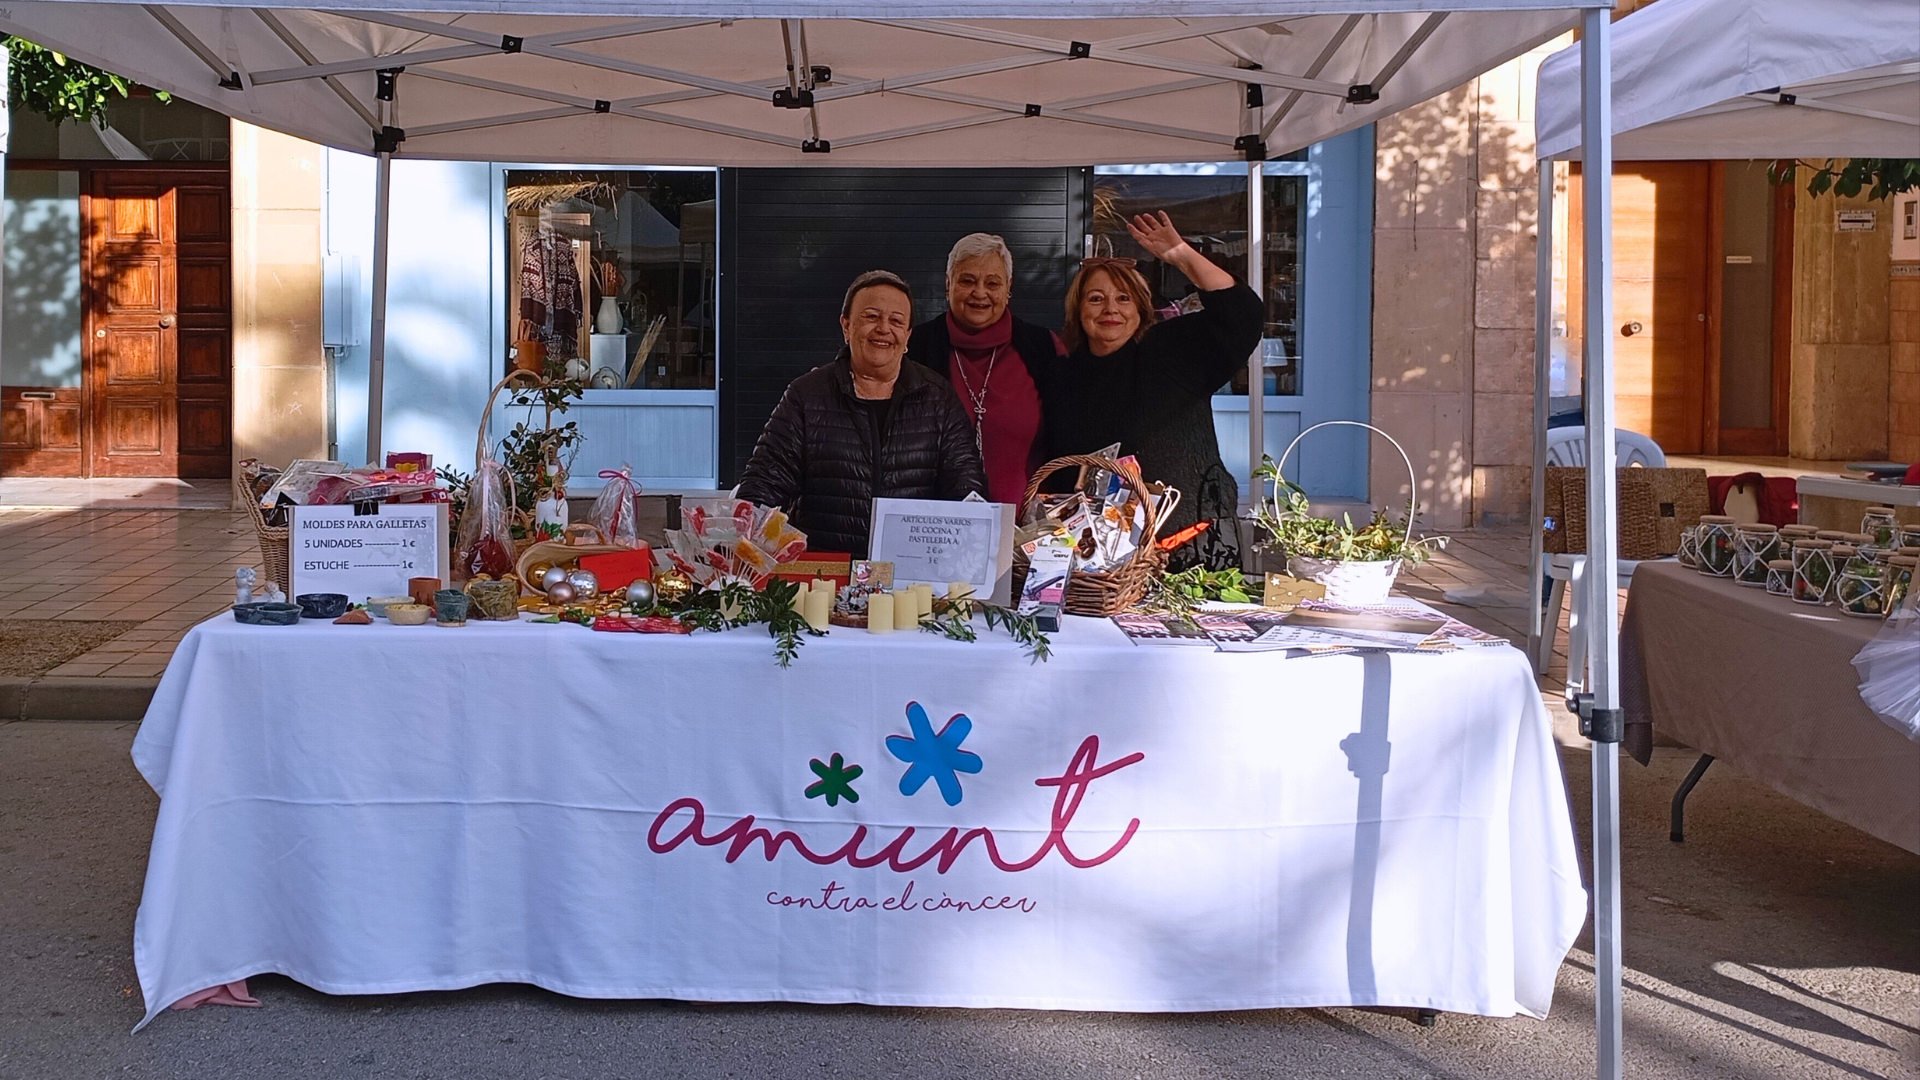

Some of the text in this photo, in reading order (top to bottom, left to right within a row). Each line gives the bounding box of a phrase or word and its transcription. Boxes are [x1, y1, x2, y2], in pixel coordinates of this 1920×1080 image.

[303, 520, 427, 529] MOLDES PARA GALLETAS
[901, 515, 972, 526] ARTÍCULOS VARIOS
[922, 526, 952, 534] COCINA
[304, 540, 310, 548] 5
[313, 539, 362, 548] UNIDADES
[402, 539, 407, 547] 1
[908, 534, 951, 544] PASTELERÍA
[926, 546, 931, 554] 2
[304, 561, 349, 570] ESTUCHE
[646, 733, 1146, 875] amunt
[766, 882, 1037, 913] contra el càncer
